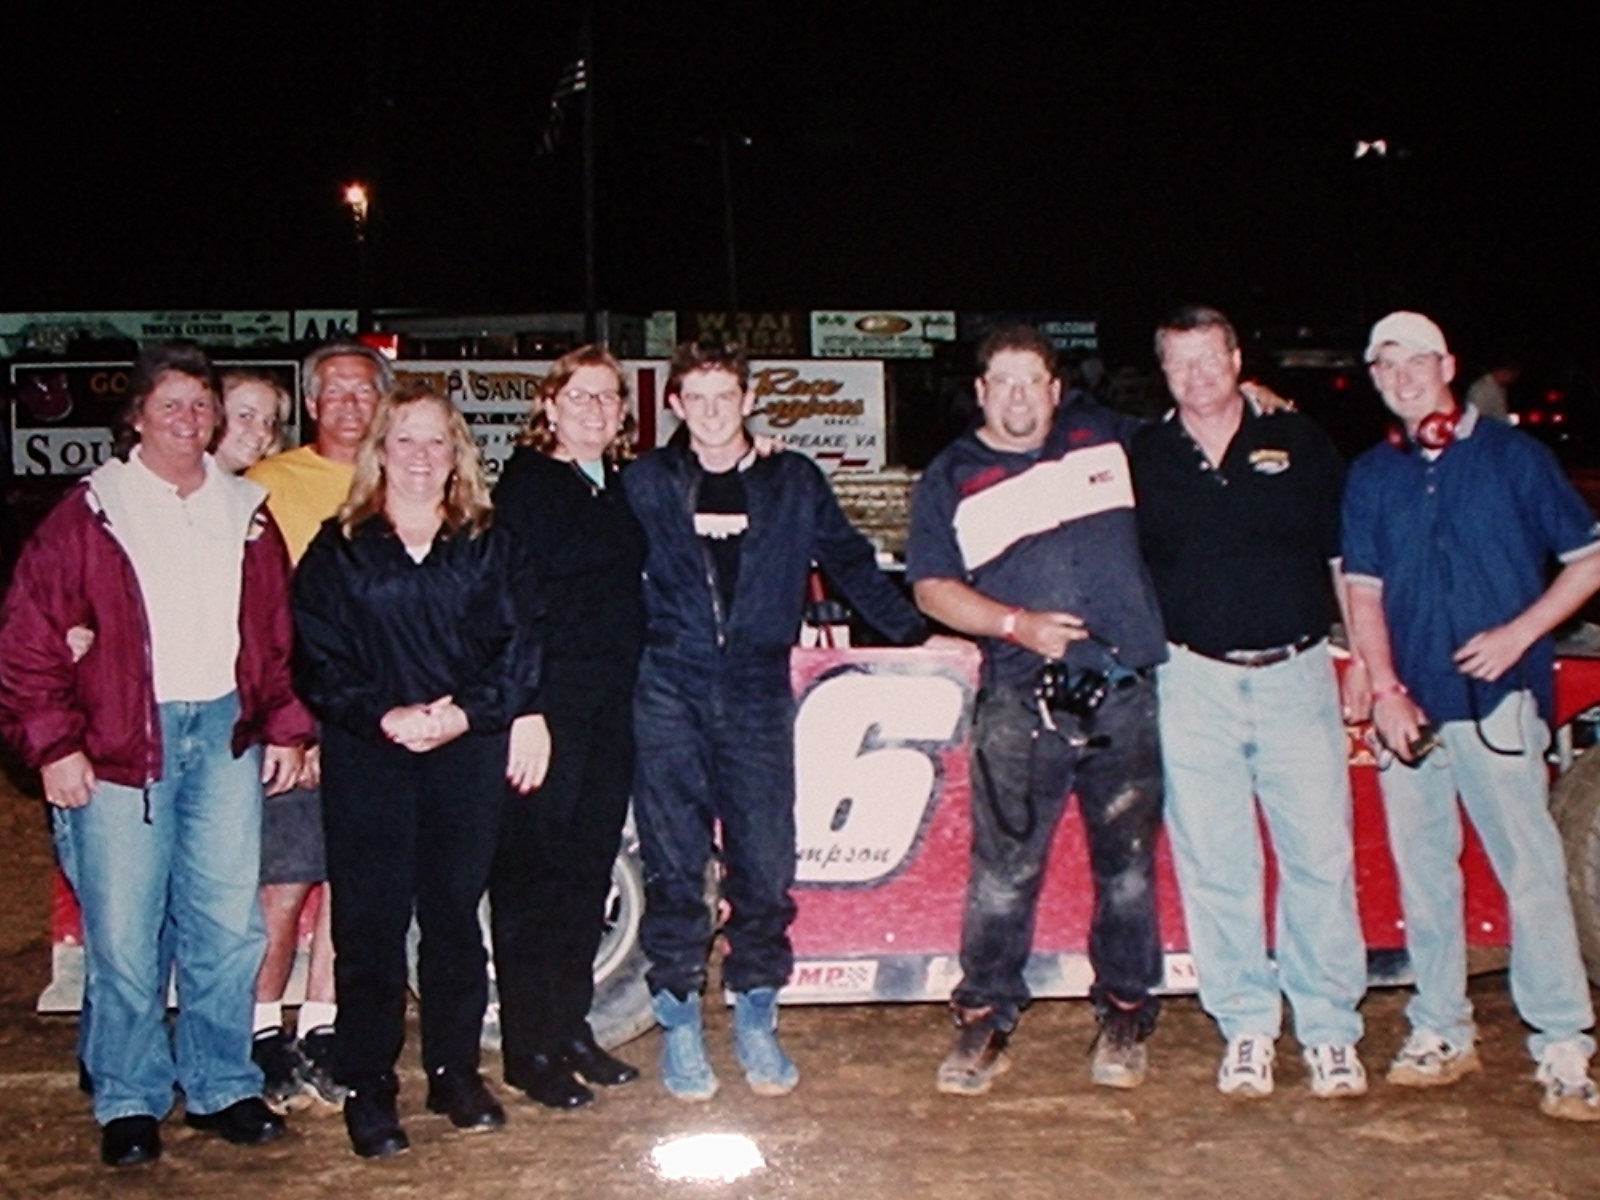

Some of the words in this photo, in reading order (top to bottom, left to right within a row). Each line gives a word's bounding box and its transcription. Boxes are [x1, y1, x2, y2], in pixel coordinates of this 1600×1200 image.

[186, 323, 233, 336] CENTER
[752, 367, 845, 402] Race
[856, 435, 877, 448] VA
[794, 668, 966, 884] 6
[796, 844, 891, 869] mpson
